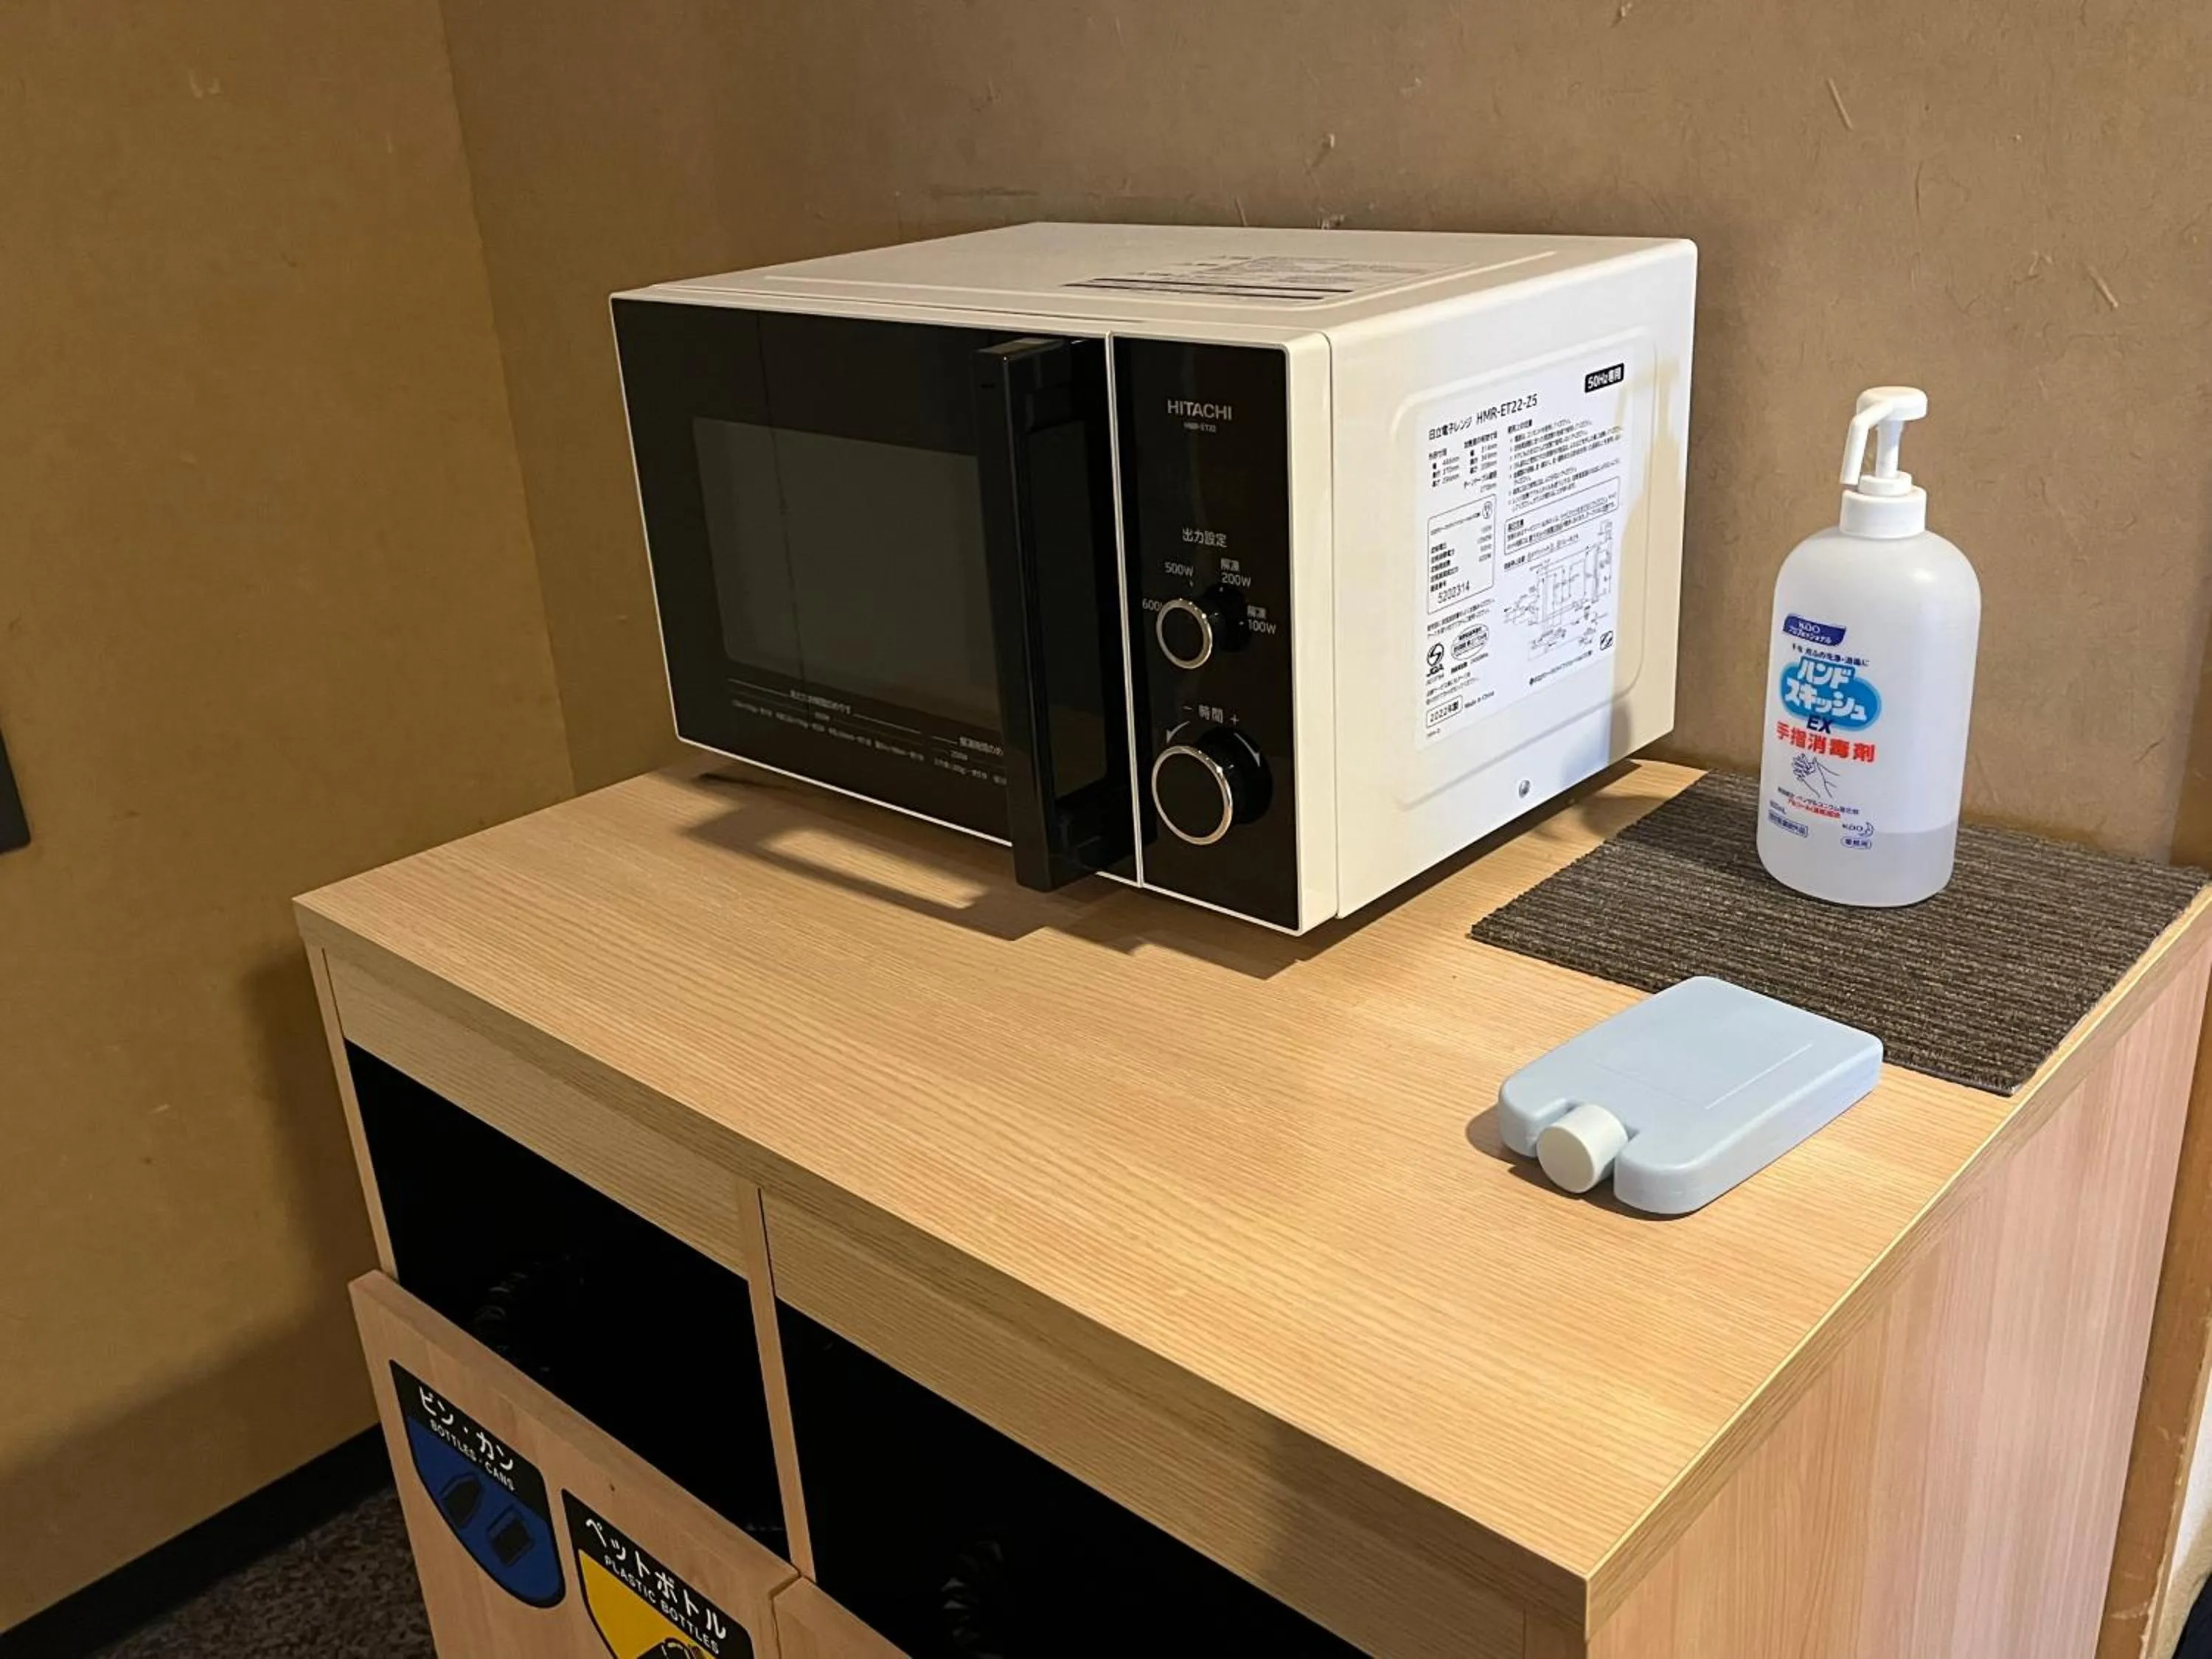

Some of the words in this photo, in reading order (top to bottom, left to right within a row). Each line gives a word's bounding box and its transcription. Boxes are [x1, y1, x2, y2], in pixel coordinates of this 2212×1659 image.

[1167, 399, 1232, 421] HITACHI
[1475, 393, 1538, 425] HMR-ET22-Z5
[1182, 527, 1227, 548] 出力設定
[1164, 561, 1194, 577] 500W
[1221, 572, 1251, 588] 200W
[1142, 598, 1163, 611] 600
[1248, 619, 1276, 635] 100W
[1797, 660, 1852, 689] ハンド
[1785, 677, 1867, 722] スキッシュ
[1807, 714, 1832, 734] EX
[1776, 720, 1876, 763] 手指消毒剤
[419, 1386, 514, 1471] ビン・カン
[585, 1518, 726, 1640] ペットボトル
[604, 1554, 656, 1604] PLASTIC
[660, 1599, 720, 1655] BOTTLES
